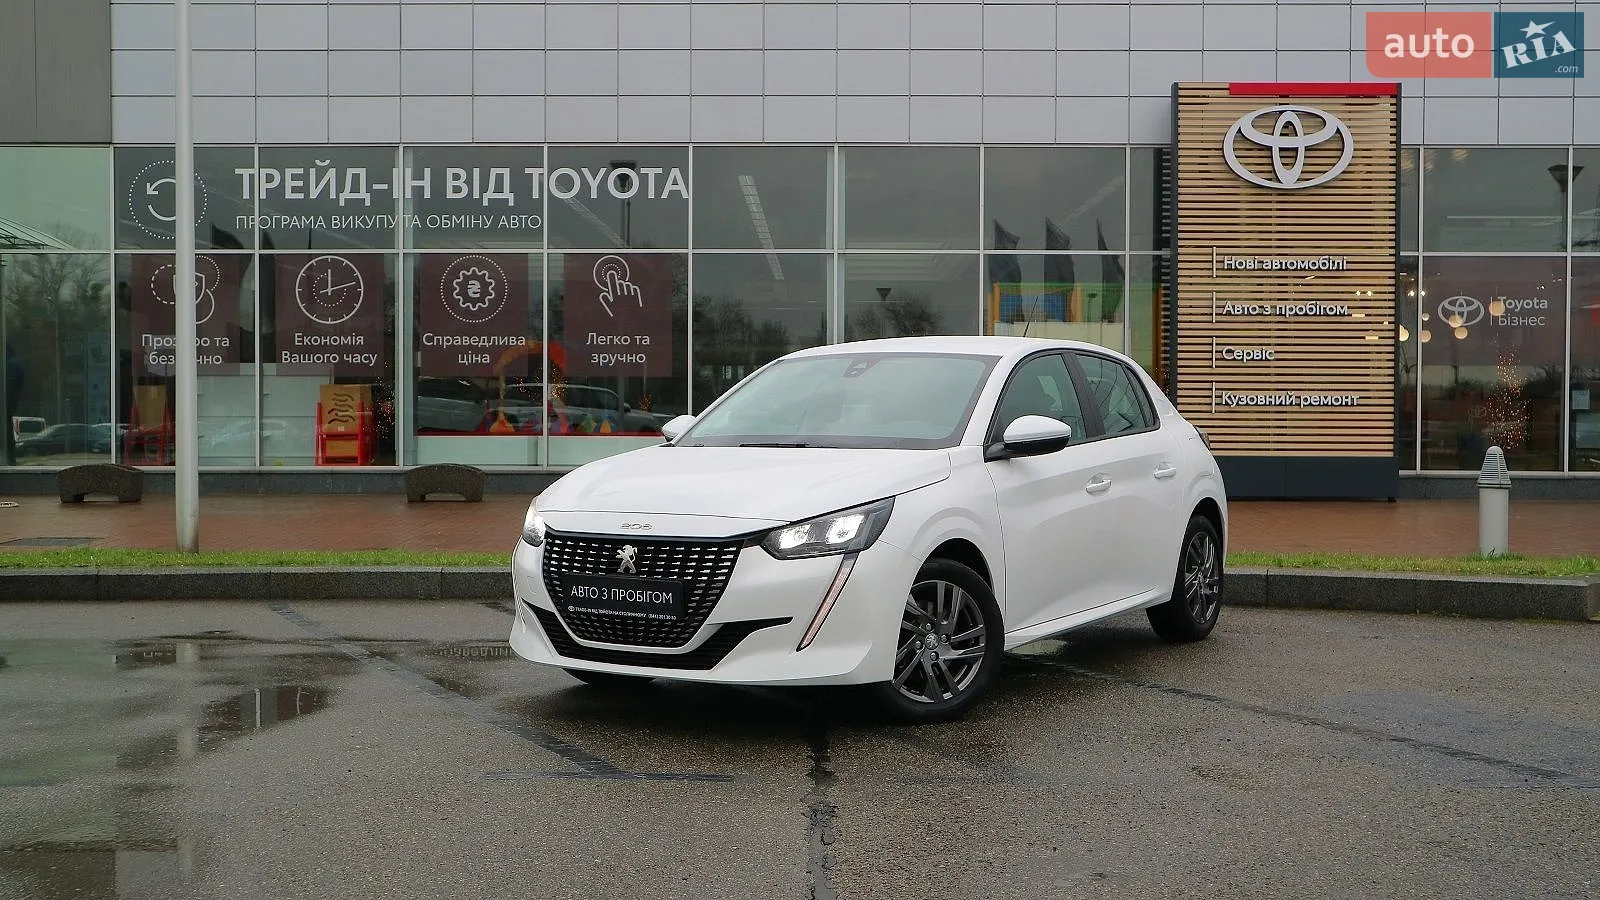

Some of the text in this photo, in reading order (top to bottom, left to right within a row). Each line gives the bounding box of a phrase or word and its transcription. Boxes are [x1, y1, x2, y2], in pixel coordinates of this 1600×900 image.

[235, 159, 689, 206] ТРЕЙД-ІН ВІД TOYOTA
[236, 215, 326, 229] ПРОГРАМА
[332, 214, 398, 229] ВИКУПУ
[426, 214, 494, 229] ОБМІНУ
[498, 214, 541, 229] АВТО
[1223, 256, 1347, 271] Нові автомобілі
[1222, 300, 1348, 317] Авто з пробігом
[1497, 296, 1548, 312] Toyota
[1498, 313, 1546, 326] Бізнес
[141, 334, 230, 349] Прозо та
[294, 332, 364, 346] Економія
[422, 333, 526, 348] Справедлива
[586, 332, 650, 345] Легко та
[149, 351, 222, 365] безчно
[281, 351, 378, 366] Вашого часу
[458, 351, 490, 365] ціна
[591, 353, 646, 366] зручно
[1222, 346, 1275, 362] Сервіс
[1221, 392, 1359, 408] Кузовний ремонт
[571, 585, 672, 603] АВТО З ПРОБІГОМ
